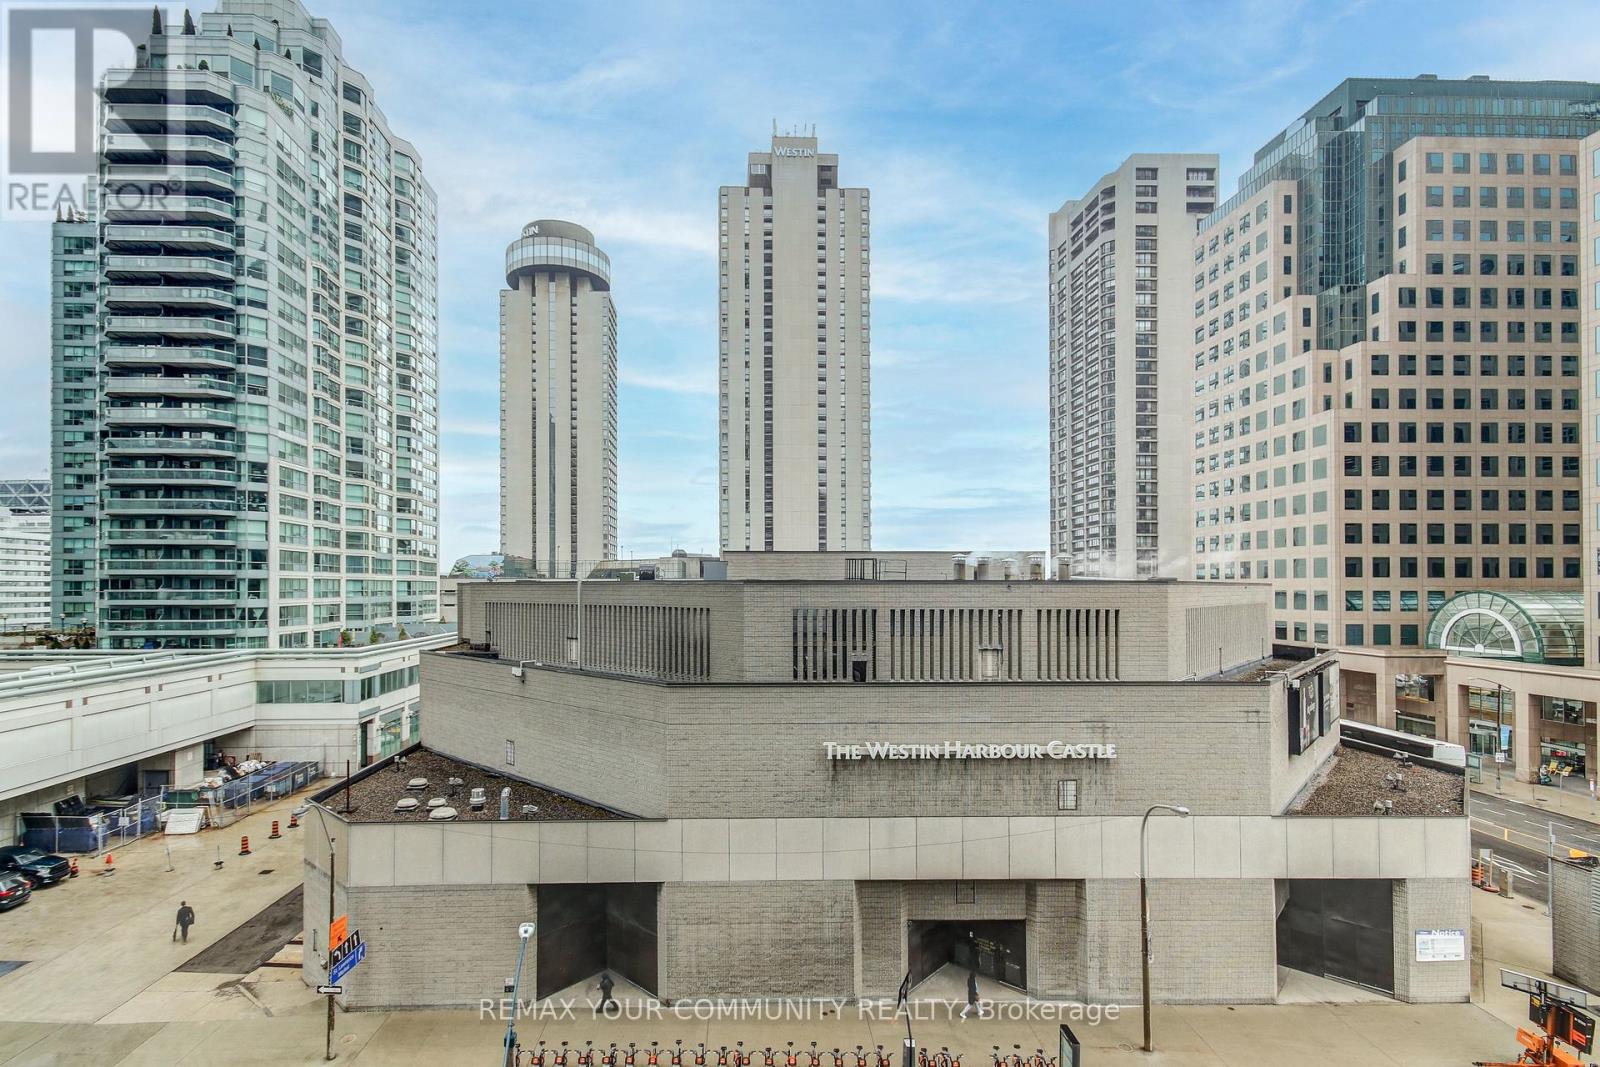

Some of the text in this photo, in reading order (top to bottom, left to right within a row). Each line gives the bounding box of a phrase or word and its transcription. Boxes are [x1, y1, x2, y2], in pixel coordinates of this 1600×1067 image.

[773, 146, 815, 157] WESTIN
[823, 740, 1117, 760] THE WESTIN HARBOUR CASTLE
